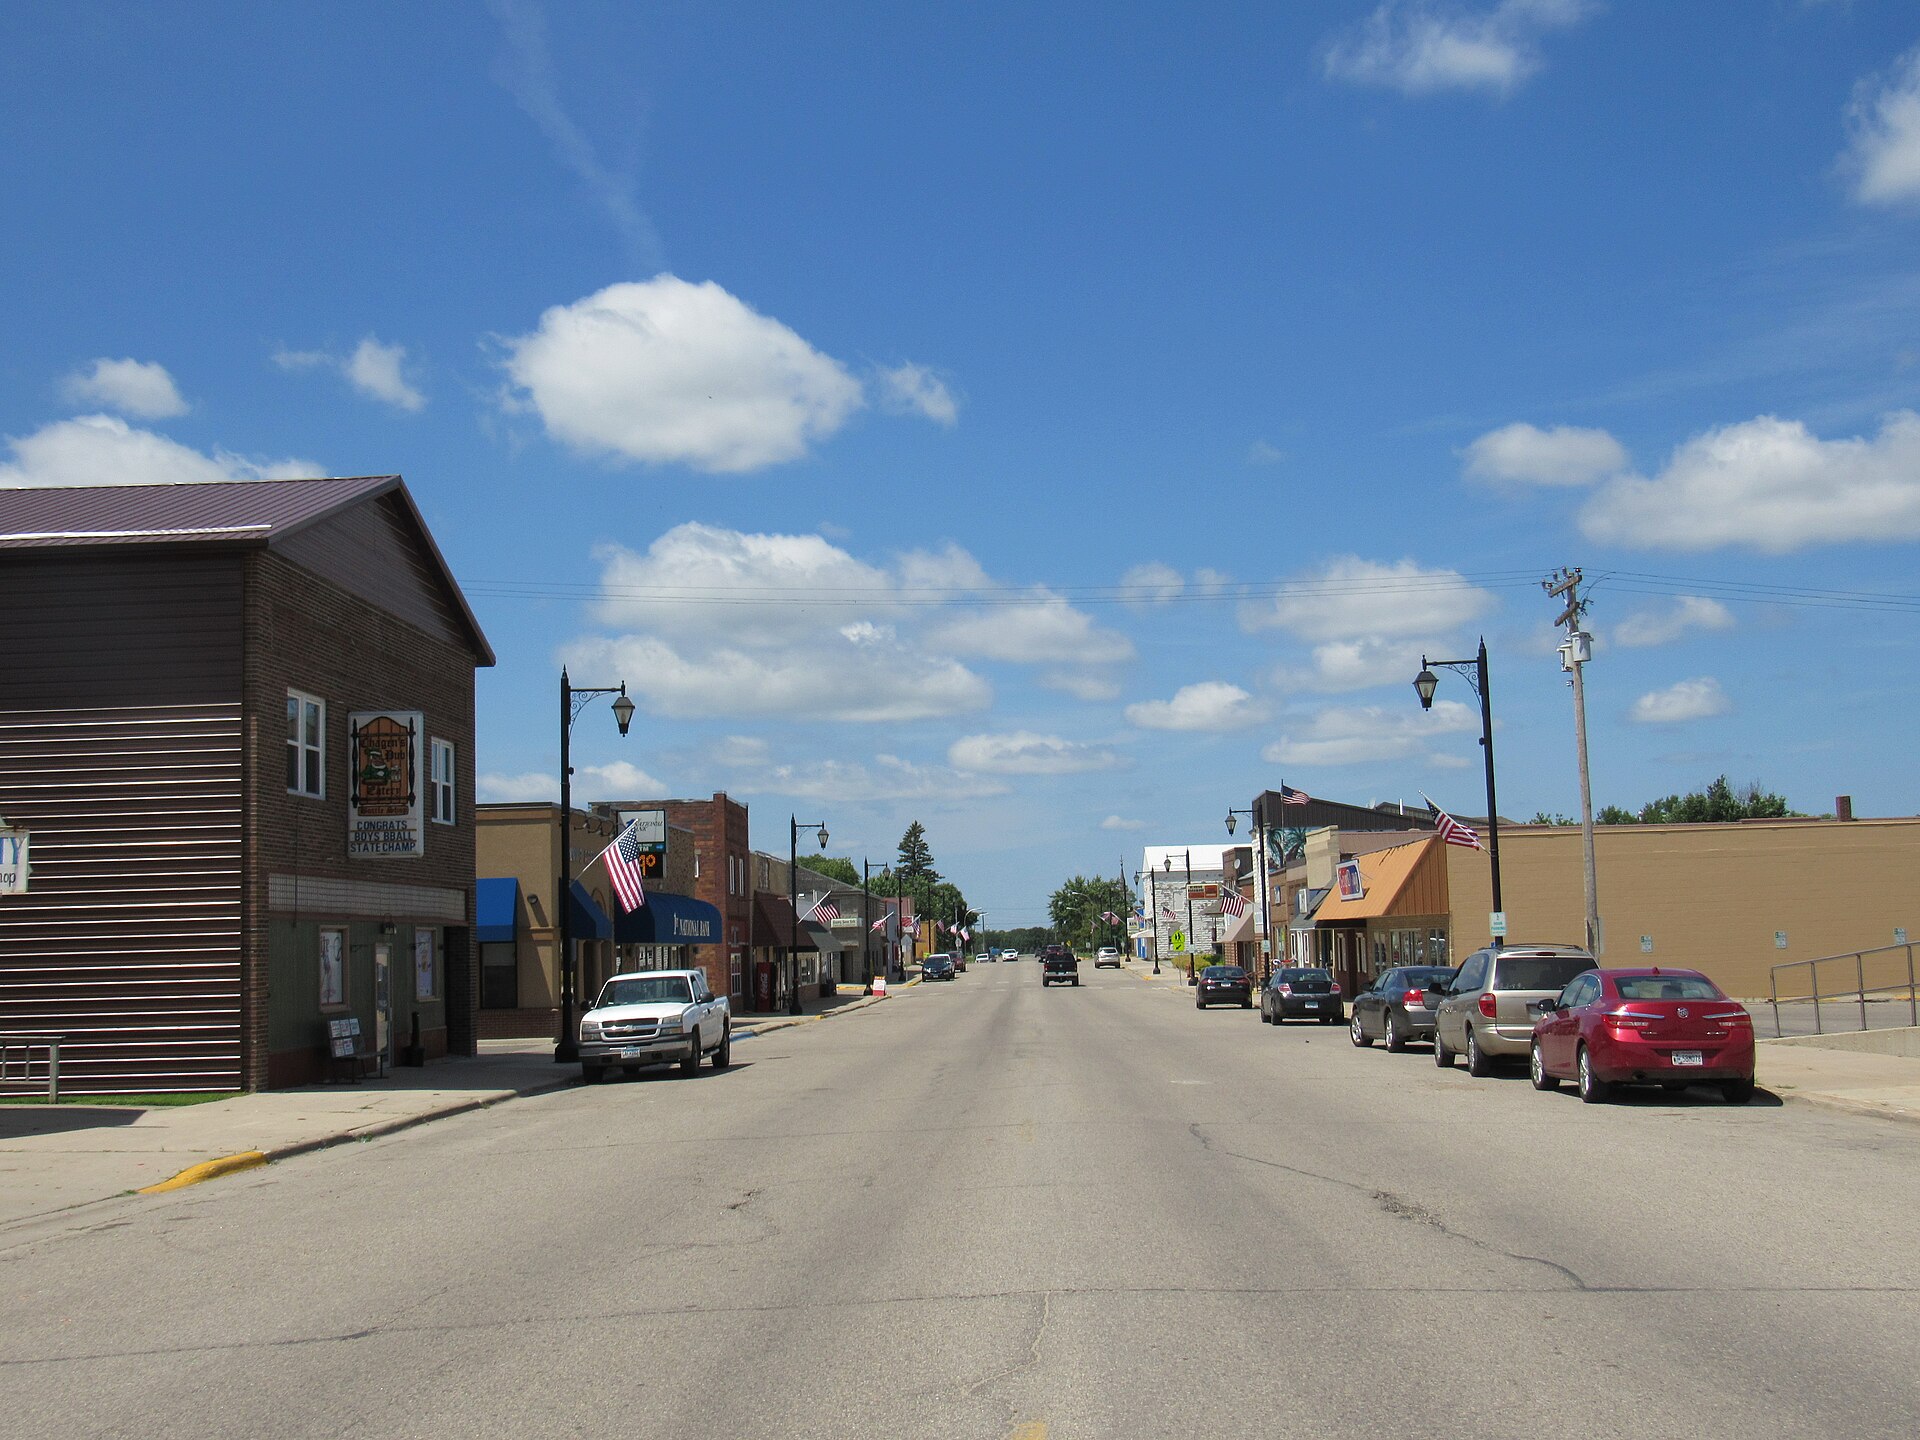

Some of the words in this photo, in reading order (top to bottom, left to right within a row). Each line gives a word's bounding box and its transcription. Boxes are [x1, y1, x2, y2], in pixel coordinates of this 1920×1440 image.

[357, 820, 408, 830] CONGRATS
[354, 831, 380, 841] BOYS
[383, 831, 413, 841] BBALL
[350, 842, 381, 852] STATE
[382, 842, 416, 852] CHAMP
